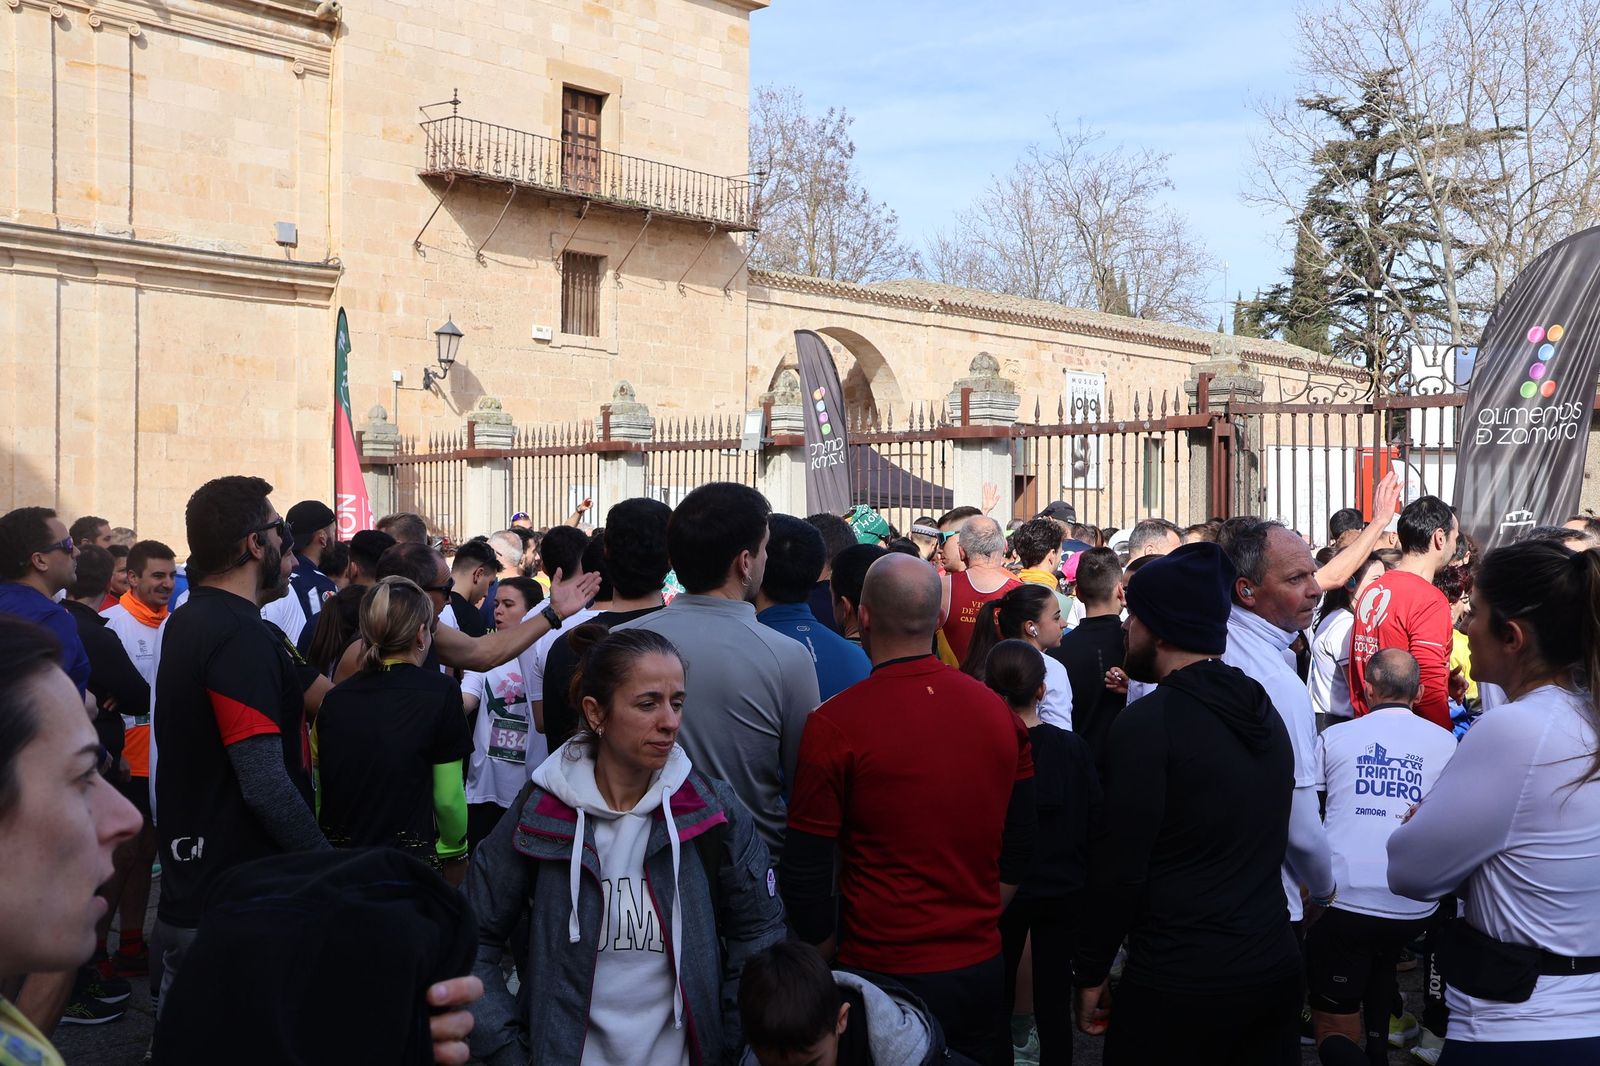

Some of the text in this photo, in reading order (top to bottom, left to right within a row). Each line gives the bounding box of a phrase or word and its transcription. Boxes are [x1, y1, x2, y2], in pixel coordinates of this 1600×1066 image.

[961, 607, 975, 615] DE
[1405, 753, 1424, 763] 2026
[1355, 765, 1422, 786] TRIATLON
[1355, 779, 1422, 803] DUERO
[1355, 807, 1387, 817] ZAMORA
